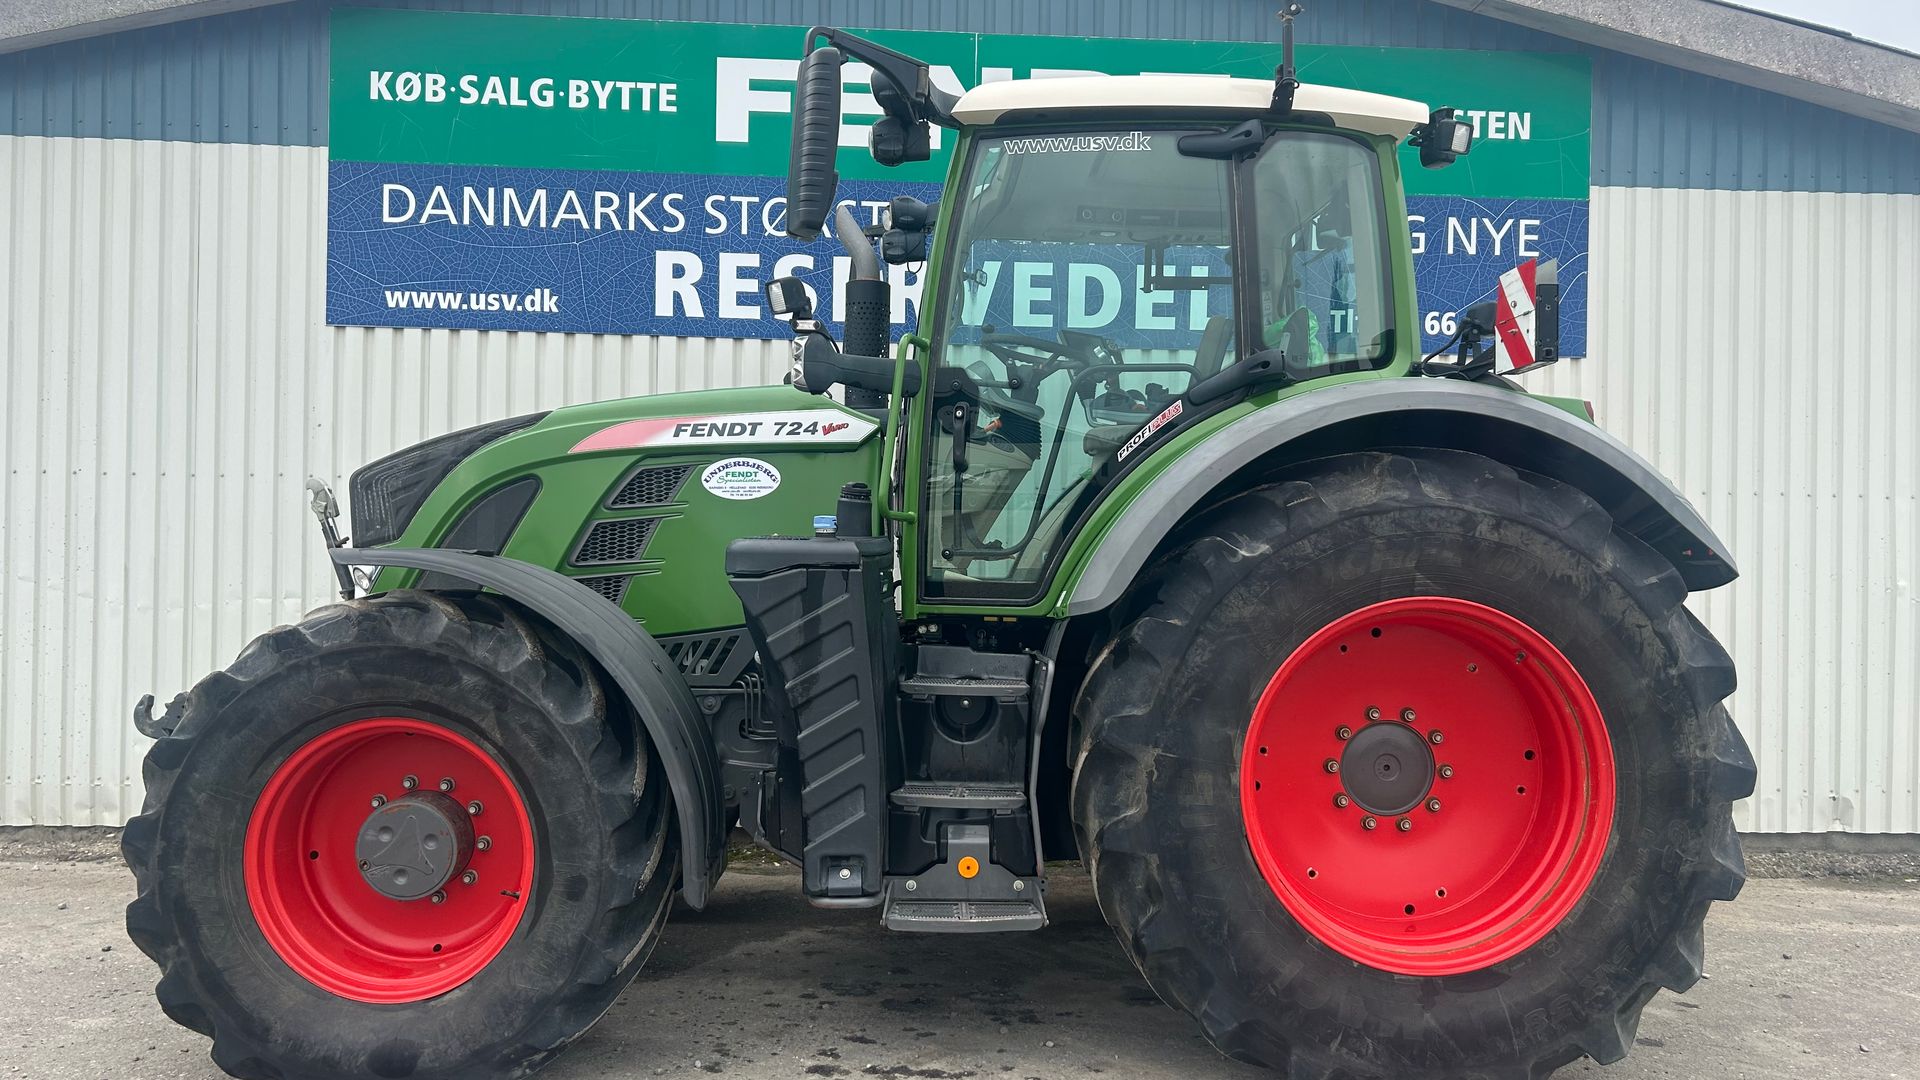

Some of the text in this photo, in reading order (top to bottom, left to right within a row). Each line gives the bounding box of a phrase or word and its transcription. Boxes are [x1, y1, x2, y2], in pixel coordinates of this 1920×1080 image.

[1004, 131, 1152, 155] www.usv.dk
[382, 183, 685, 233] DANMARKS
[1447, 216, 1541, 257] NYE
[384, 287, 560, 314] www.usv.dk
[672, 421, 763, 438] FENDT
[773, 421, 819, 436] 724
[703, 460, 778, 484] UNDERBJERG
[717, 475, 762, 485] Specialisten
